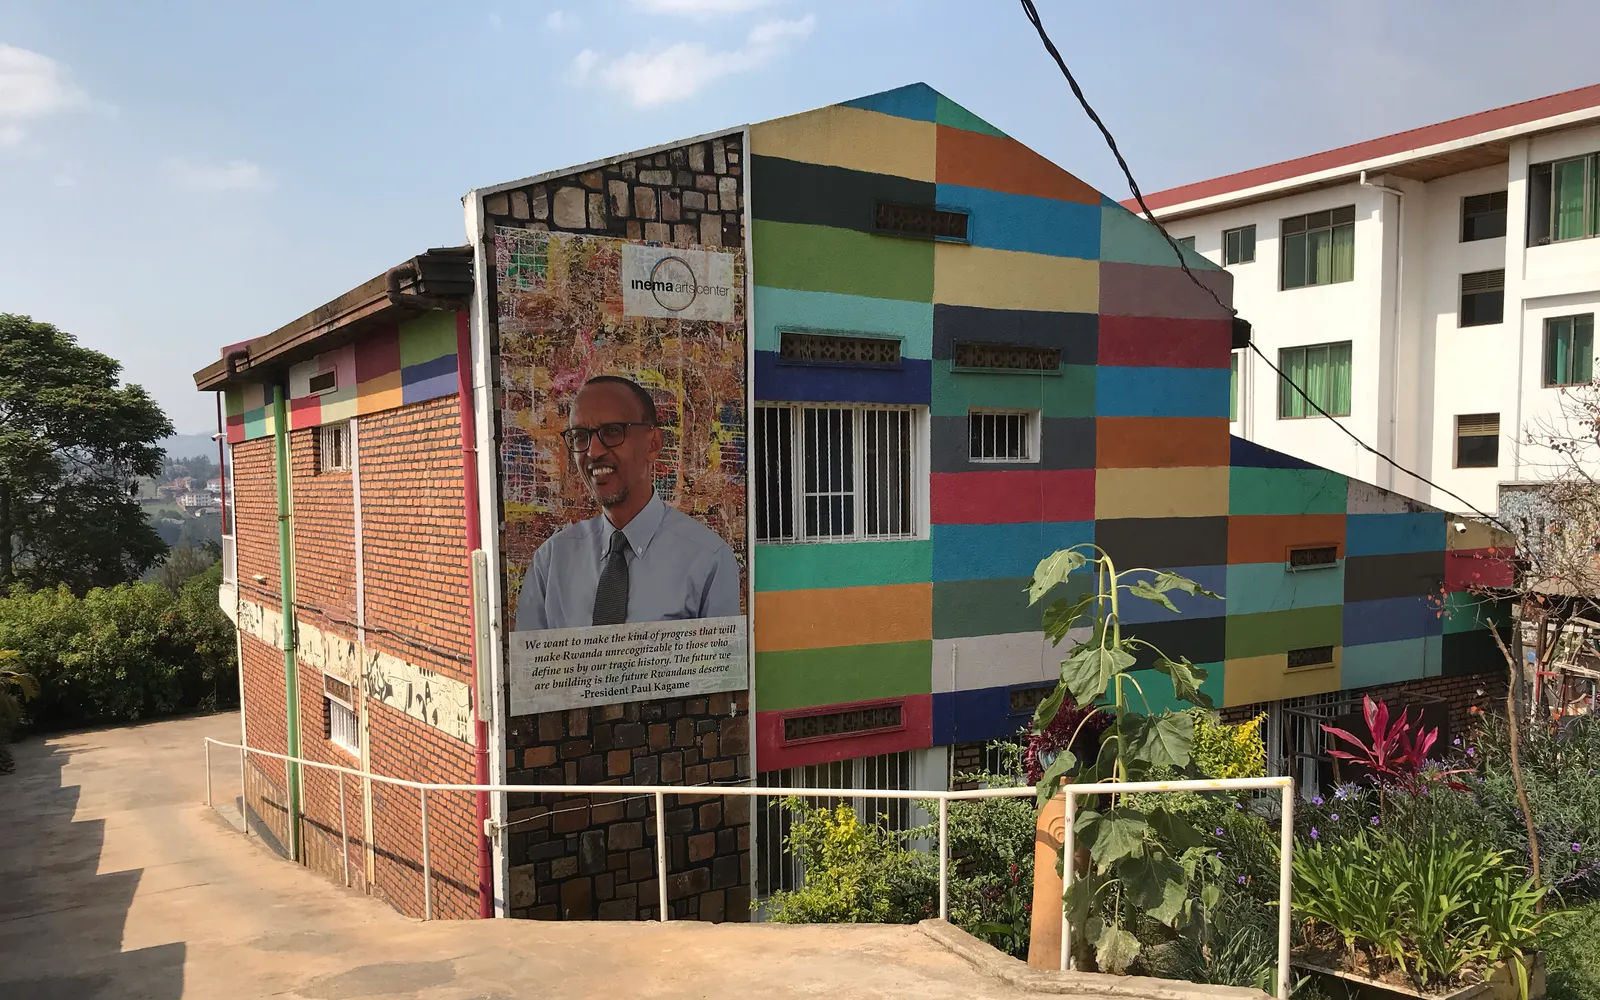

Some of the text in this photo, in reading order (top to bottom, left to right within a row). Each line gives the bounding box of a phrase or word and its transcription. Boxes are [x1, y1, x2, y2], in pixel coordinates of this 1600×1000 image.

[675, 281, 696, 294] arts
[696, 284, 730, 296] center
[525, 624, 736, 650] We want to make the kind of progress that will
[534, 638, 728, 663] make Rwanda unrecognizable to those who
[532, 652, 732, 678] define us by our tragic history. The future we
[534, 664, 730, 691] are building is the future Rwandans deserve
[580, 681, 690, 699] -President Paul Kagame
